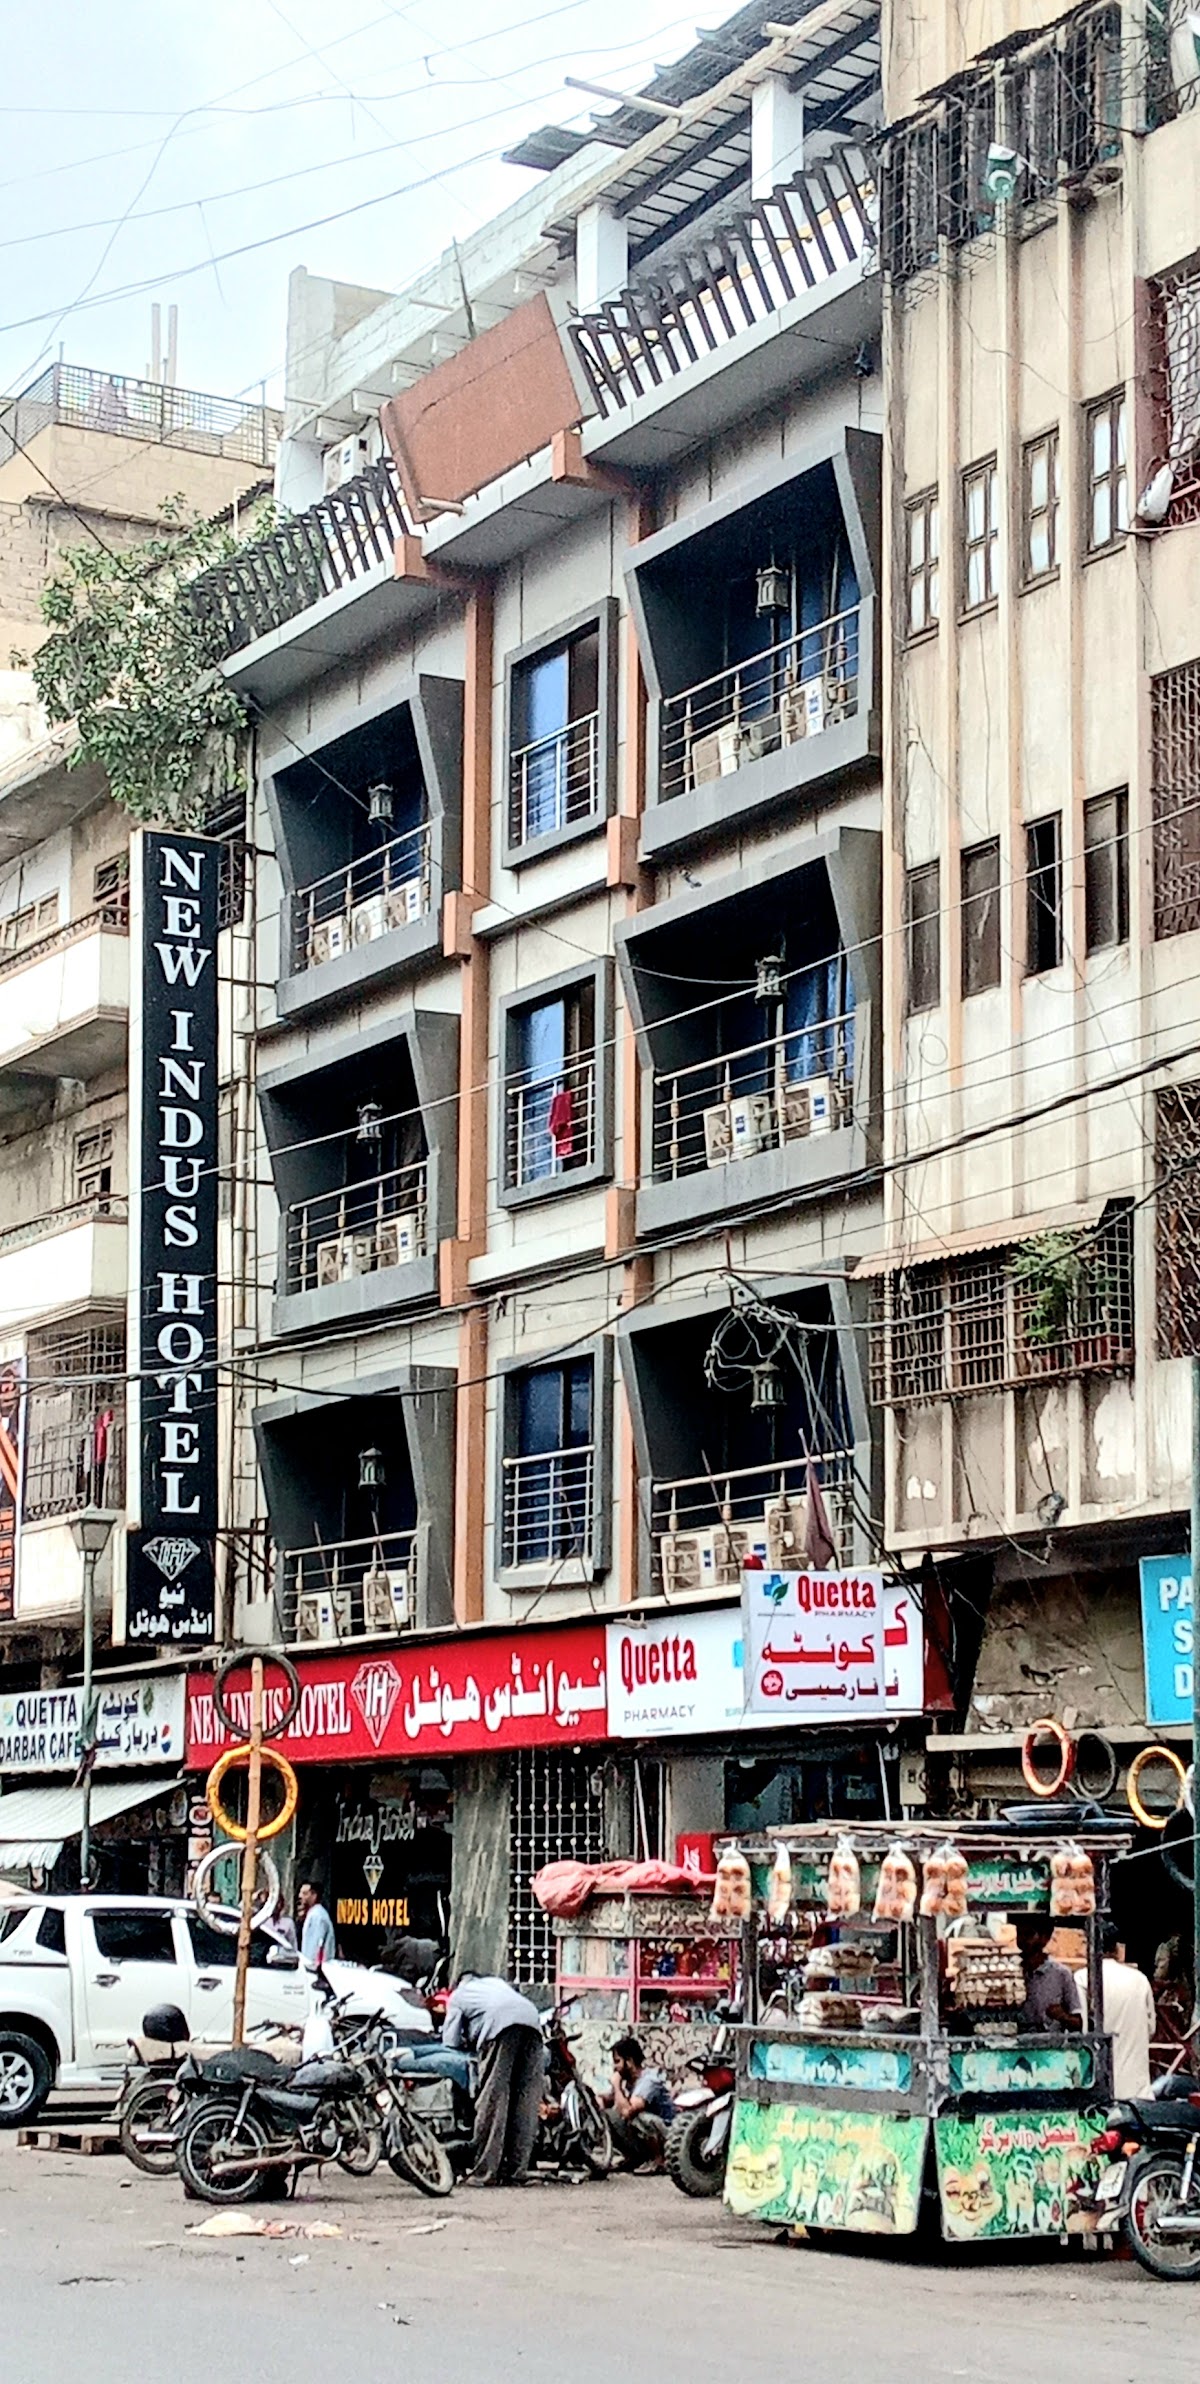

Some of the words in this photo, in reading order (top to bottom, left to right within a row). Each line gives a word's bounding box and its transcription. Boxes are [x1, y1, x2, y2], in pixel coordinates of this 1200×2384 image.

[154, 846, 212, 988] NEW
[158, 1010, 206, 1248] INDUS
[157, 1271, 205, 1515] HOTEL
[159, 1582, 185, 1610] نیو
[797, 1575, 877, 1614] Quetta
[172, 1607, 213, 1639] انڈس
[814, 1611, 876, 1619] PHARMACY
[621, 1633, 698, 1695] Quetta
[761, 1631, 875, 1671] کوئٹہ
[484, 1652, 555, 1732] انڈس
[555, 1657, 606, 1727] نیو
[785, 1677, 879, 1701] فارمیسی
[16, 1694, 77, 1726] QUETTA
[624, 1704, 697, 1723] PHARMACY
[337, 1898, 369, 1926] INDUS
[372, 1897, 411, 1926] HOTEL
